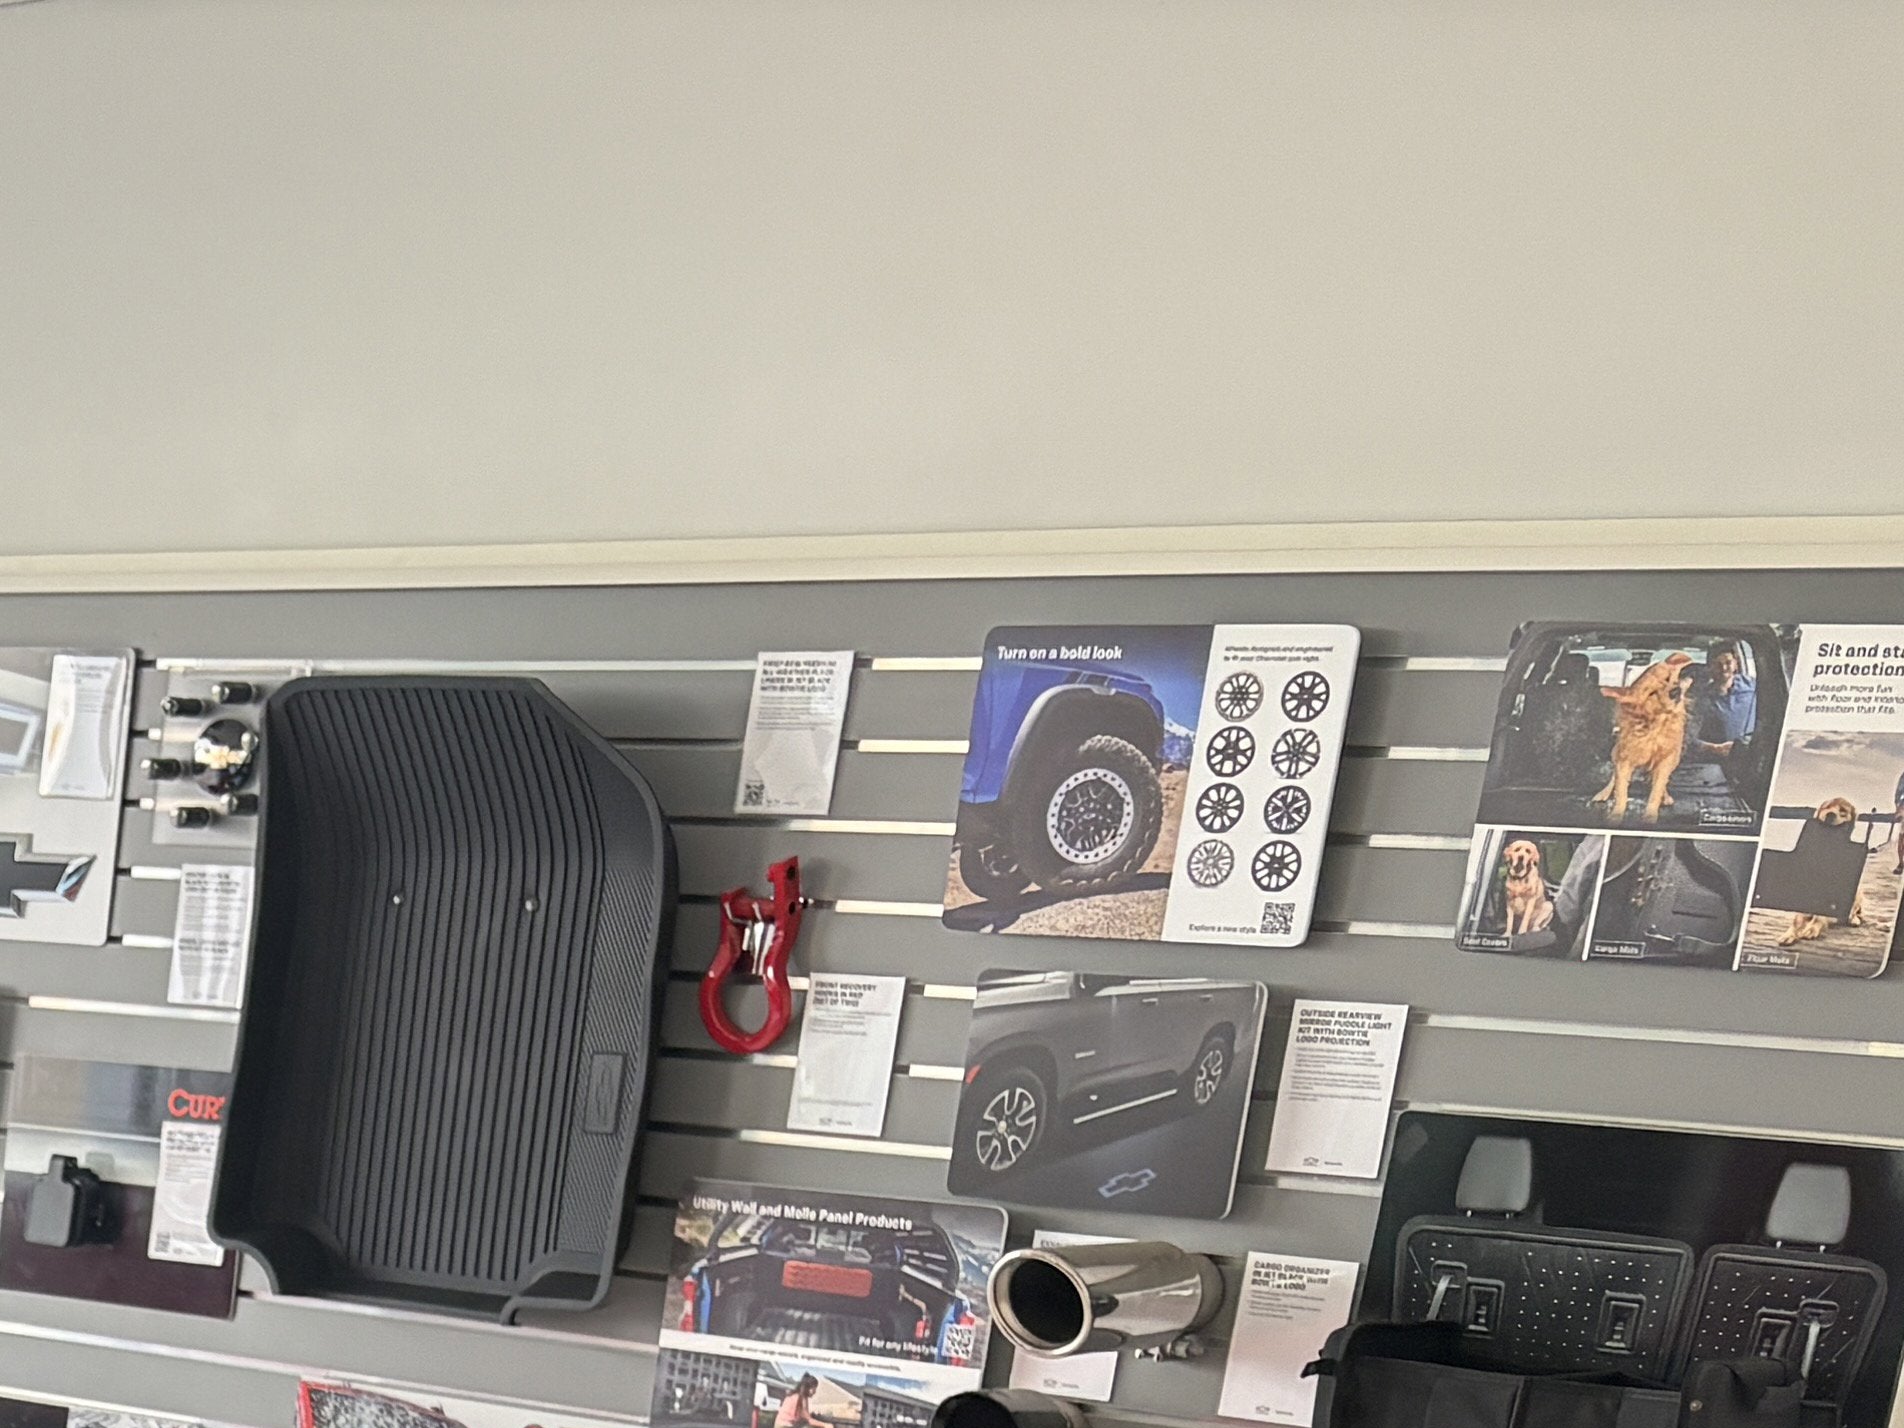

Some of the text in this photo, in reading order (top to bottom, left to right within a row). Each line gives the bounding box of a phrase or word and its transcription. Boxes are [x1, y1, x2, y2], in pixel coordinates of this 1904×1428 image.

[998, 646, 1122, 659] Turn on a bold look
[1818, 643, 1842, 657] Sit
[1846, 644, 1879, 657] and
[1813, 662, 1904, 677] protection
[1189, 923, 1215, 932] Explore
[1239, 925, 1256, 934] style
[840, 983, 877, 991] RECOVERY
[1300, 1009, 1382, 1020] OUTSIDE REARVIEW
[1299, 1018, 1392, 1030] MIRROR PUDDLE LIGHT
[1337, 1029, 1368, 1038] BOWTIE
[1320, 1037, 1370, 1046] PROJECTION
[168, 1088, 225, 1120] CUR
[693, 1197, 912, 1231] Utility Wall and Molle Panel Products
[1254, 1261, 1330, 1275] CARGO ORGANIZER
[873, 1337, 885, 1349] for
[886, 1340, 901, 1352] any
